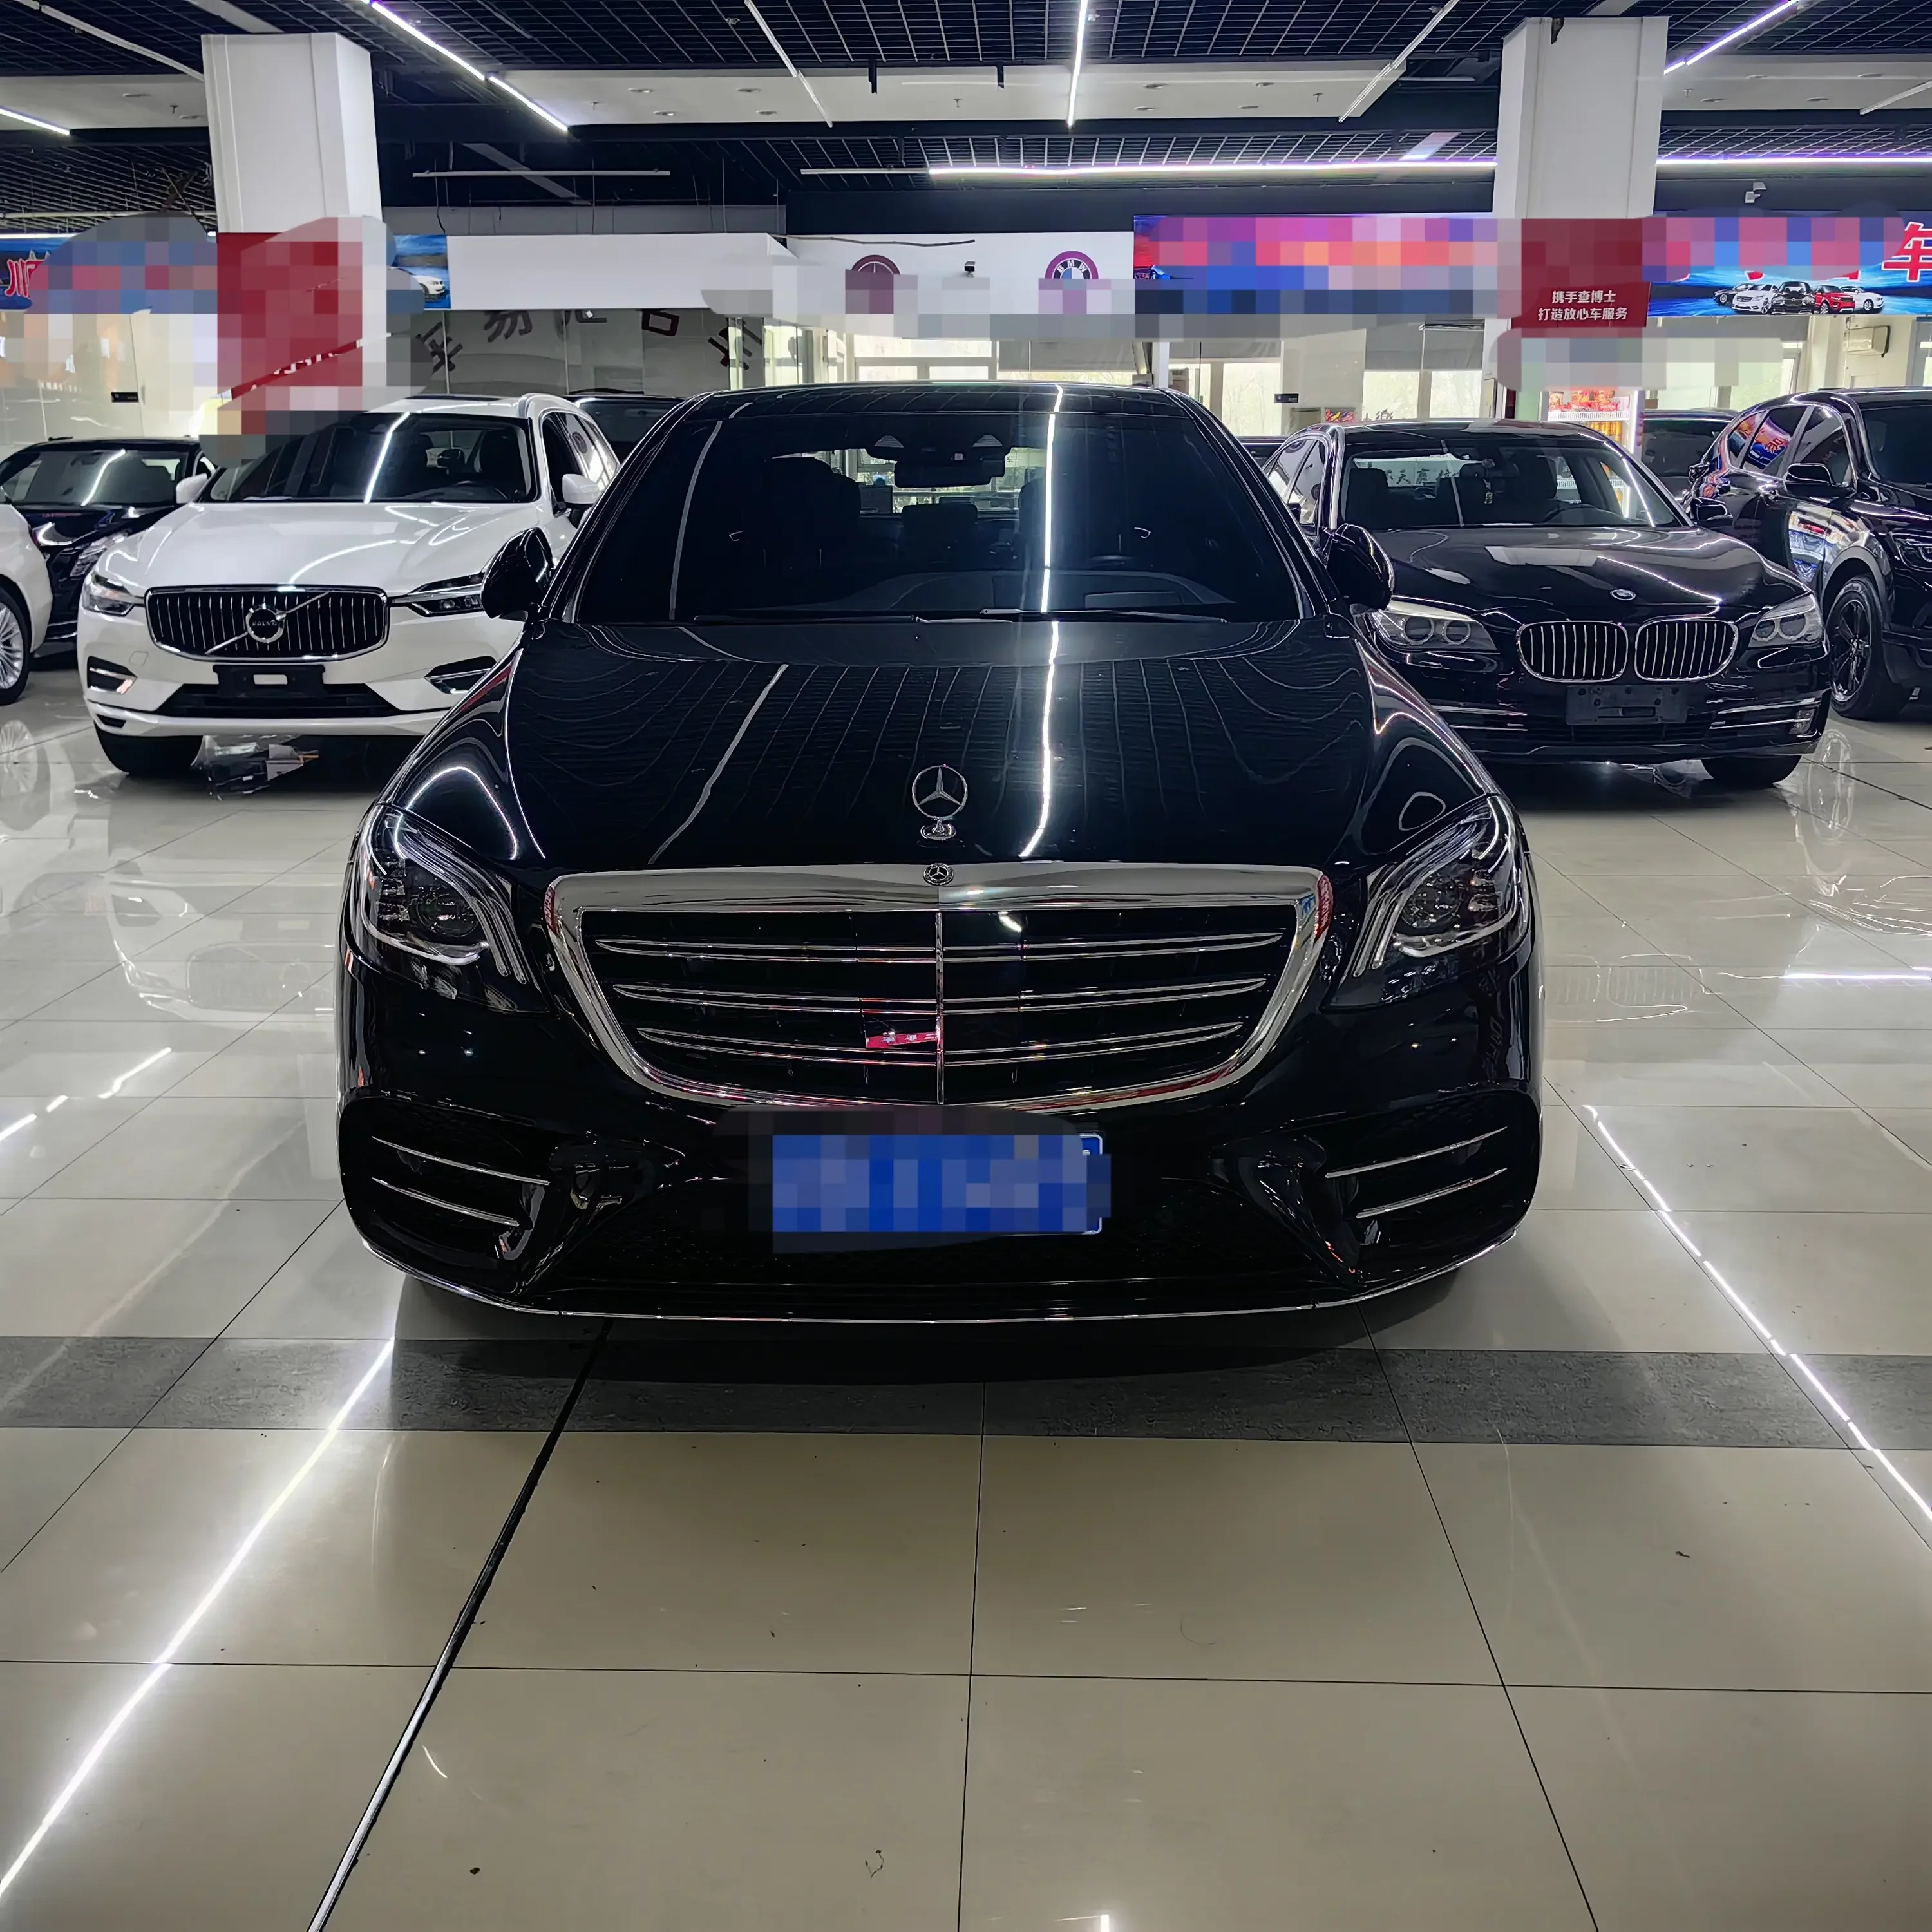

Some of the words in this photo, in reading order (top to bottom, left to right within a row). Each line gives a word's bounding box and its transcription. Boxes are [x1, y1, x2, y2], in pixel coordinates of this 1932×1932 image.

[1057, 260, 1088, 273] BMW
[1551, 290, 1616, 304] 携手查博士
[1537, 307, 1628, 321] 打造放心车服务
